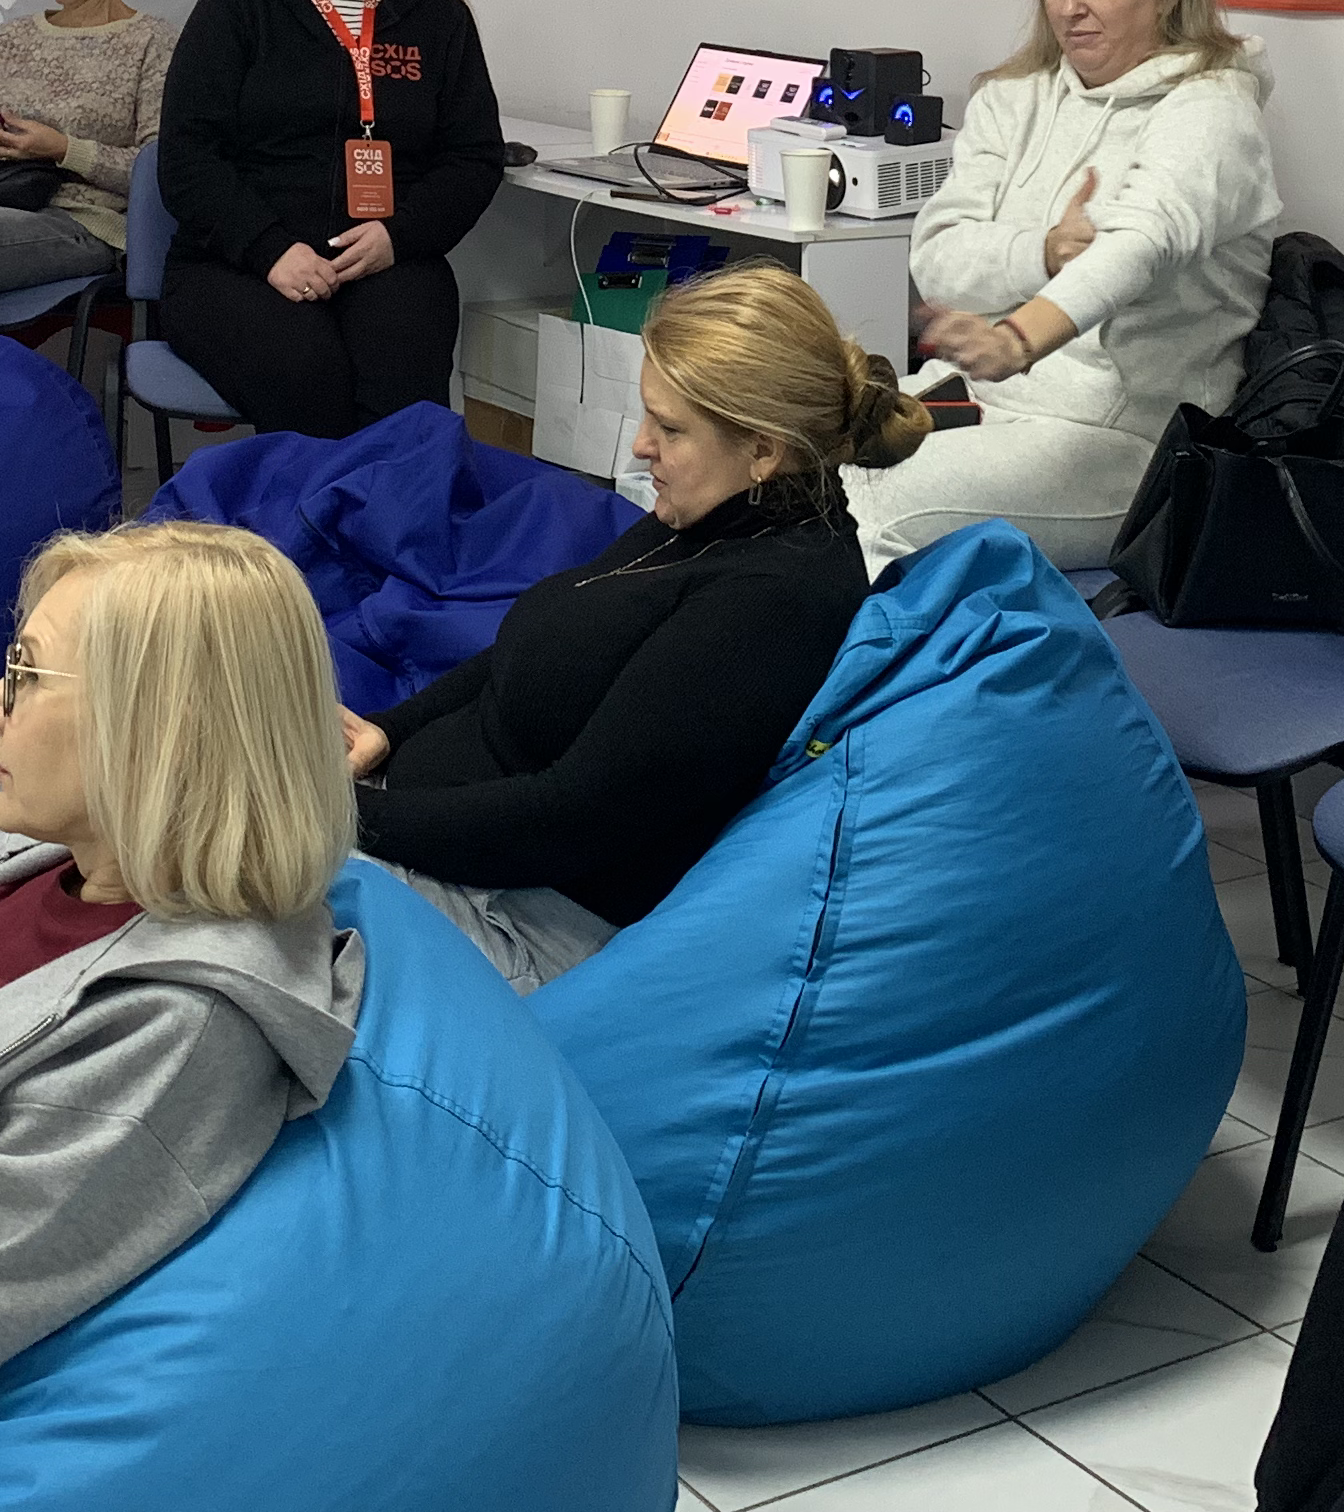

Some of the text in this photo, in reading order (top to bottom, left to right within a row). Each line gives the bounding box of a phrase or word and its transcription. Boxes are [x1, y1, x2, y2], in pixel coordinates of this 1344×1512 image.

[371, 43, 422, 61] СХІД
[370, 60, 422, 82] SOS
[353, 148, 384, 161] СХІД
[354, 160, 384, 175] SOS
